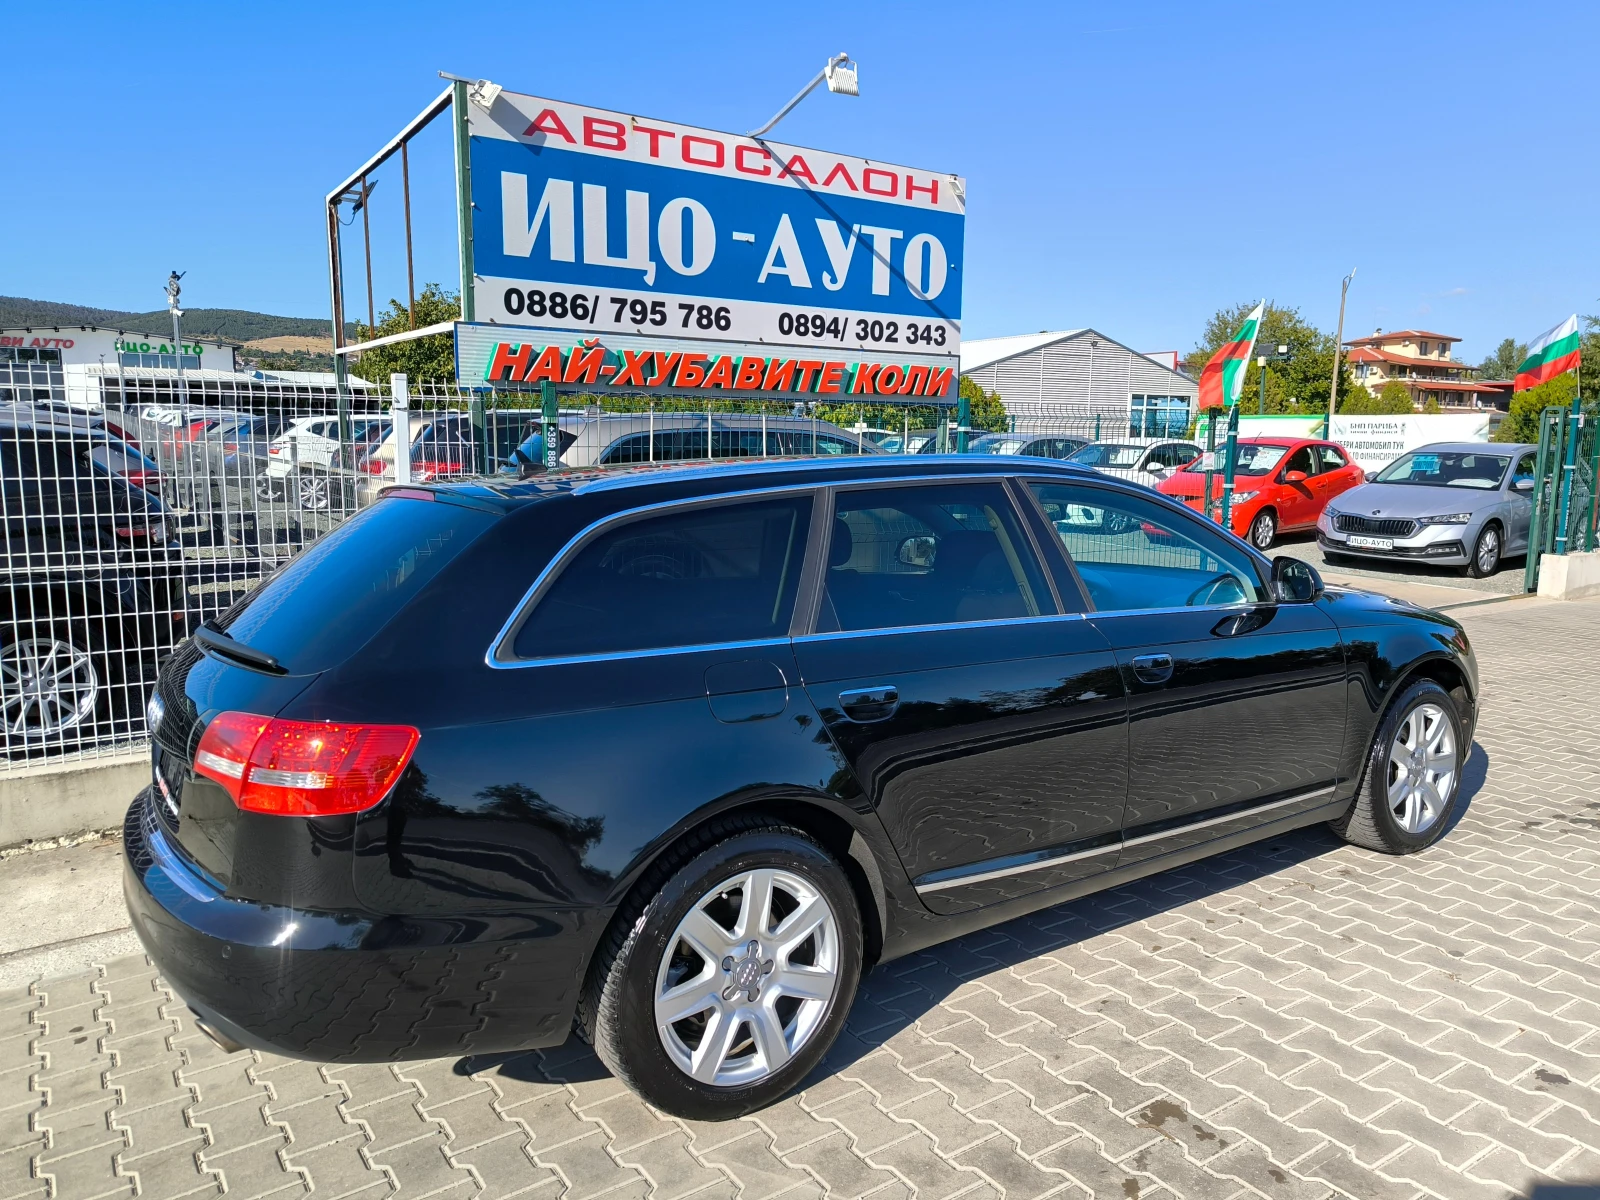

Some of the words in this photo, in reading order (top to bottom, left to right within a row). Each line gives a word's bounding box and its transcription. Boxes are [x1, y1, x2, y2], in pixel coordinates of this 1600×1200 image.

[522, 108, 939, 204] АВТОСАЛОН
[503, 288, 600, 324] 0886/
[610, 297, 667, 326] 795
[678, 303, 731, 331] 786
[778, 312, 849, 341] 0894/
[855, 319, 898, 343] 302
[906, 323, 947, 346] 343
[29, 338, 75, 349] АУТО
[485, 337, 847, 394] НАЙ-ХУБАВИТЕ
[850, 362, 954, 397] КОЛИ
[547, 425, 557, 448] +359
[1354, 441, 1392, 450] АВТОМОБИЛ
[1392, 440, 1404, 450] ТУК
[547, 450, 557, 468] 886
[1351, 537, 1392, 547] ИЦО-АУТО
